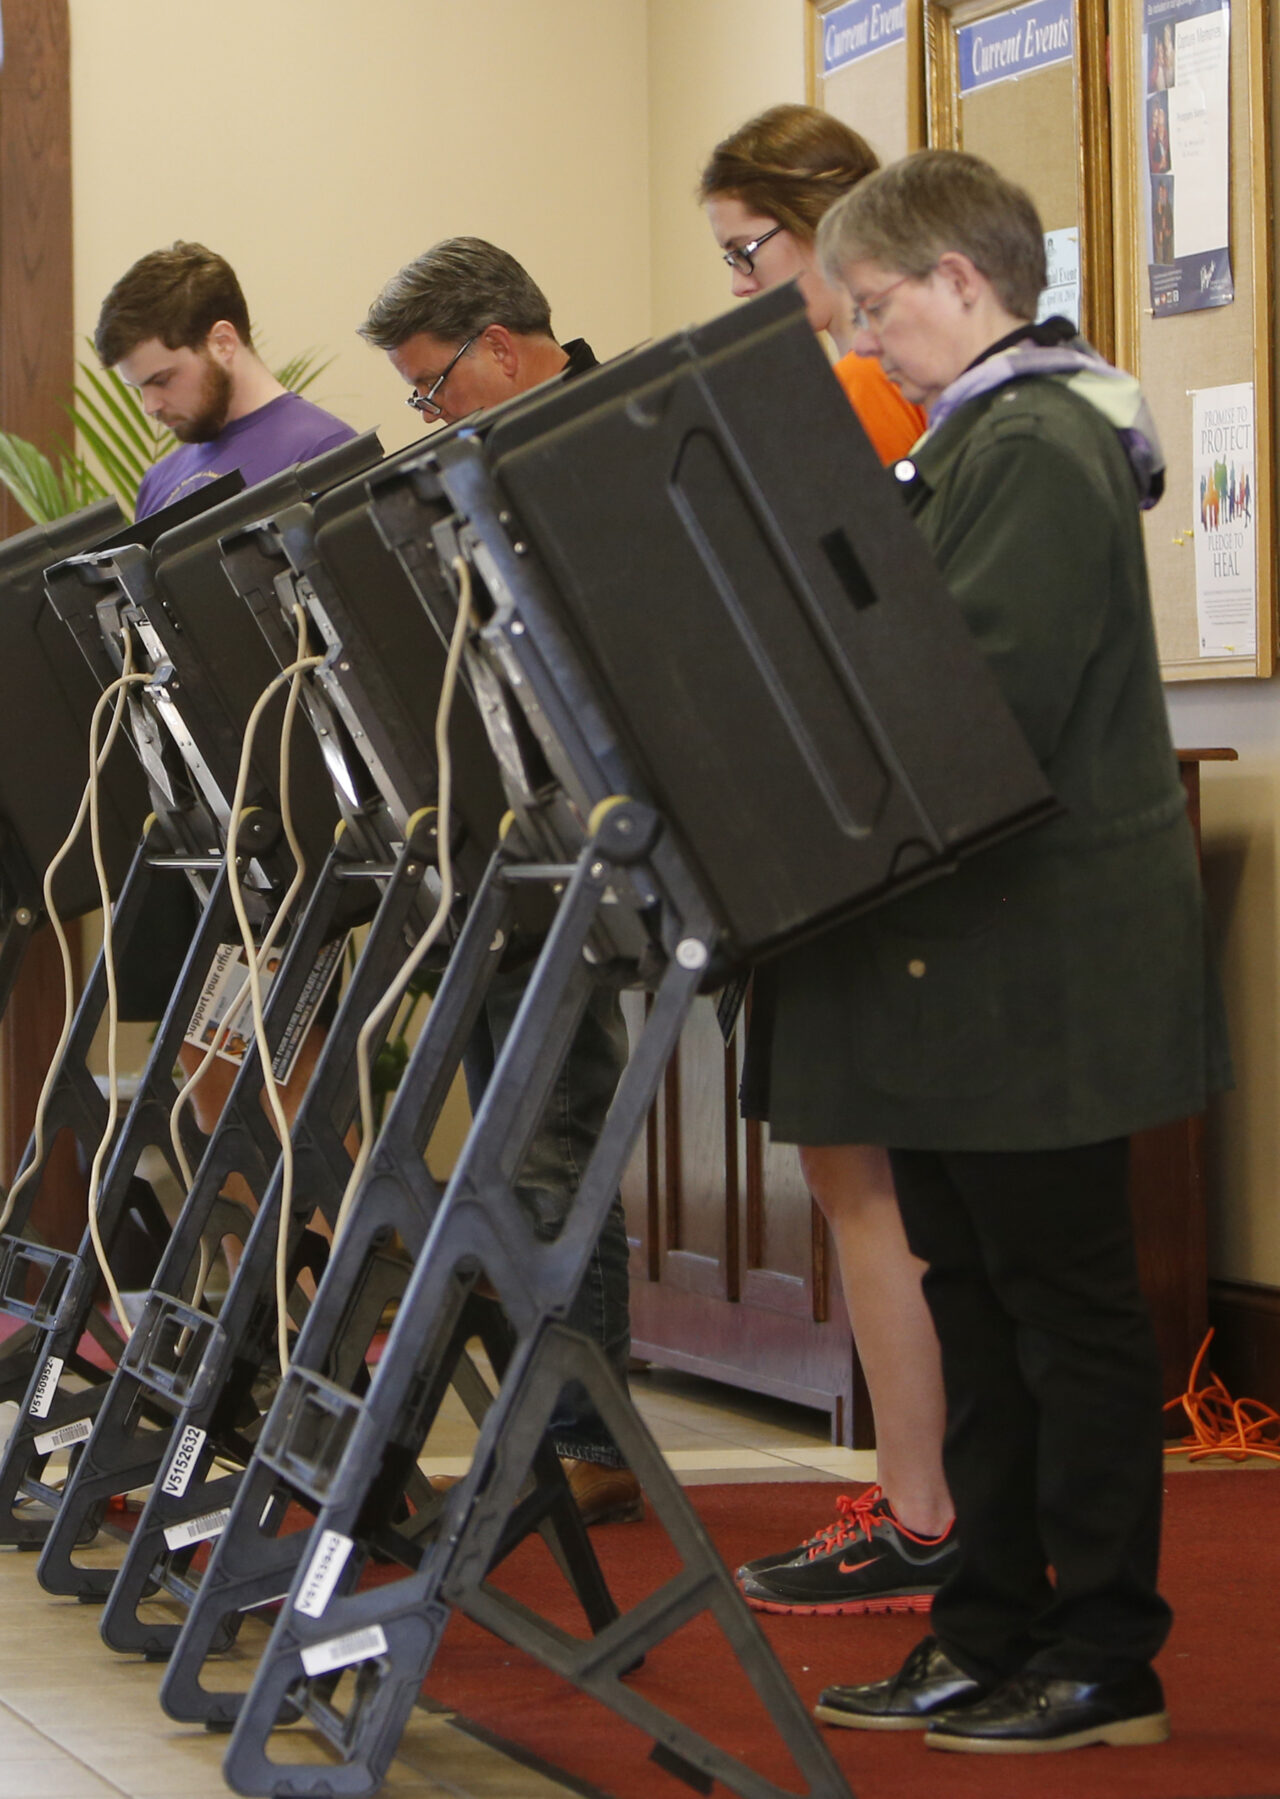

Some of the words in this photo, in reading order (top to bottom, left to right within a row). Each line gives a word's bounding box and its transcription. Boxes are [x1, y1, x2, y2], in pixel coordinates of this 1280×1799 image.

[826, 14, 868, 61] Current
[972, 27, 1022, 75] Current
[1024, 14, 1069, 58] Events
[1237, 405, 1248, 423] TO
[1200, 424, 1251, 455] PROTECT
[1234, 532, 1245, 549] TO
[1213, 551, 1240, 577] HEAL
[185, 996, 209, 1038] Support
[204, 974, 221, 997] your
[165, 1428, 200, 1491] V5152632
